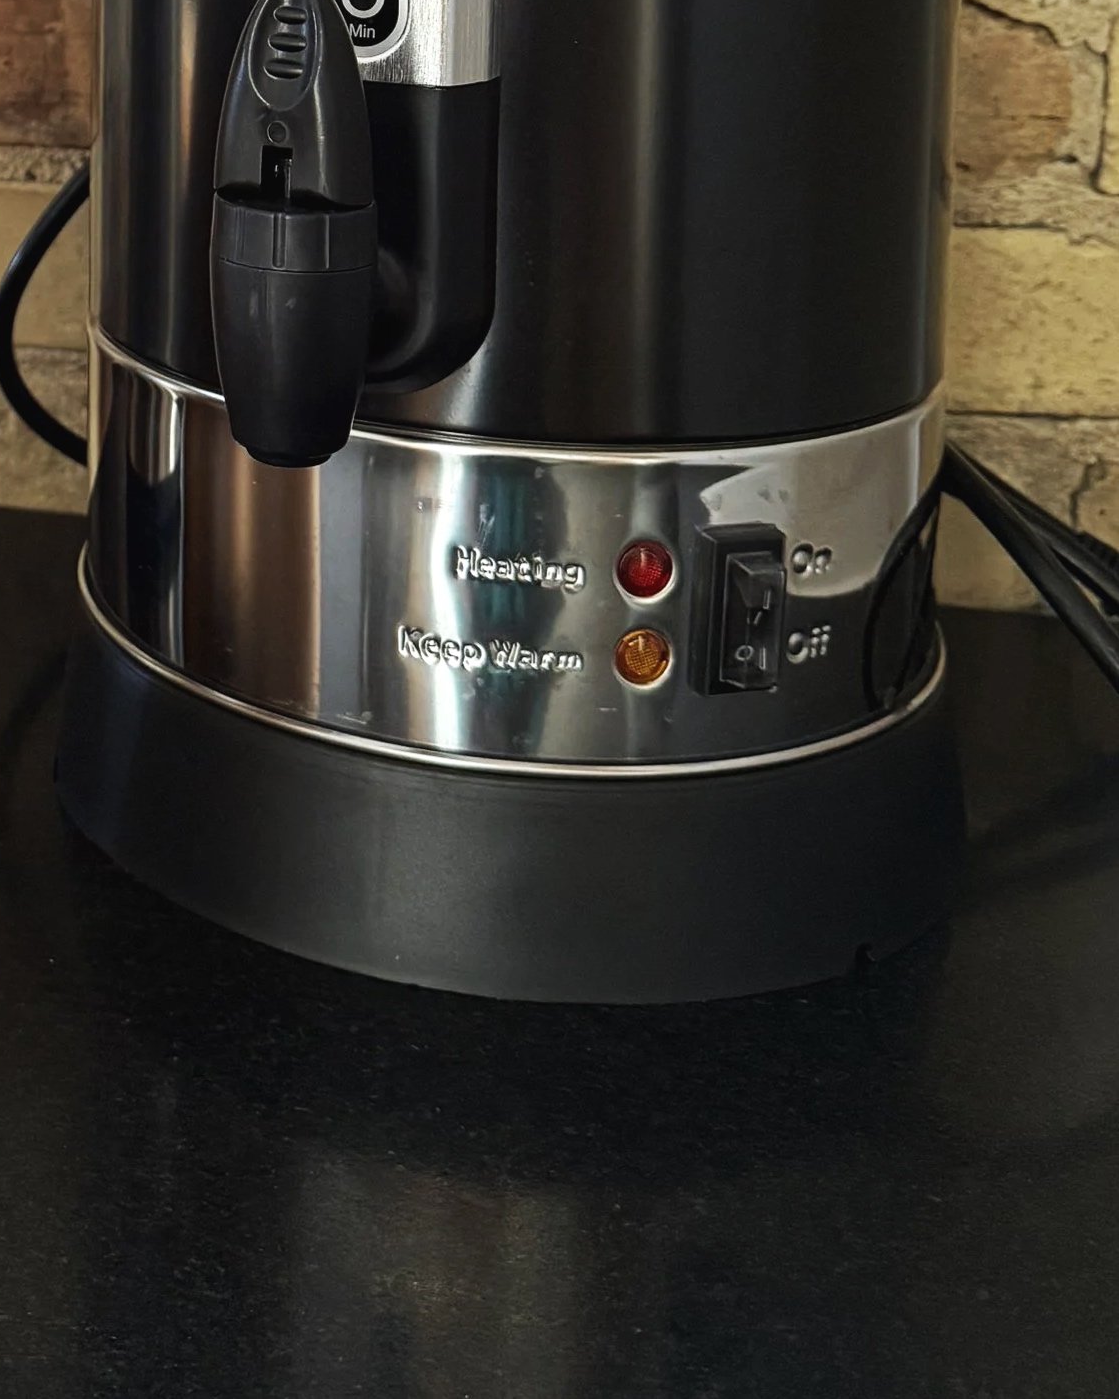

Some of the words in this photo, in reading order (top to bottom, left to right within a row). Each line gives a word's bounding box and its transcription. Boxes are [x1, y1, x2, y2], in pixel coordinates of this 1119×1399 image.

[349, 23, 376, 39] Min
[455, 544, 586, 594] Heating
[790, 541, 833, 577] On
[397, 624, 487, 673] Keep
[489, 638, 584, 673] Warm
[786, 624, 832, 665] Off
